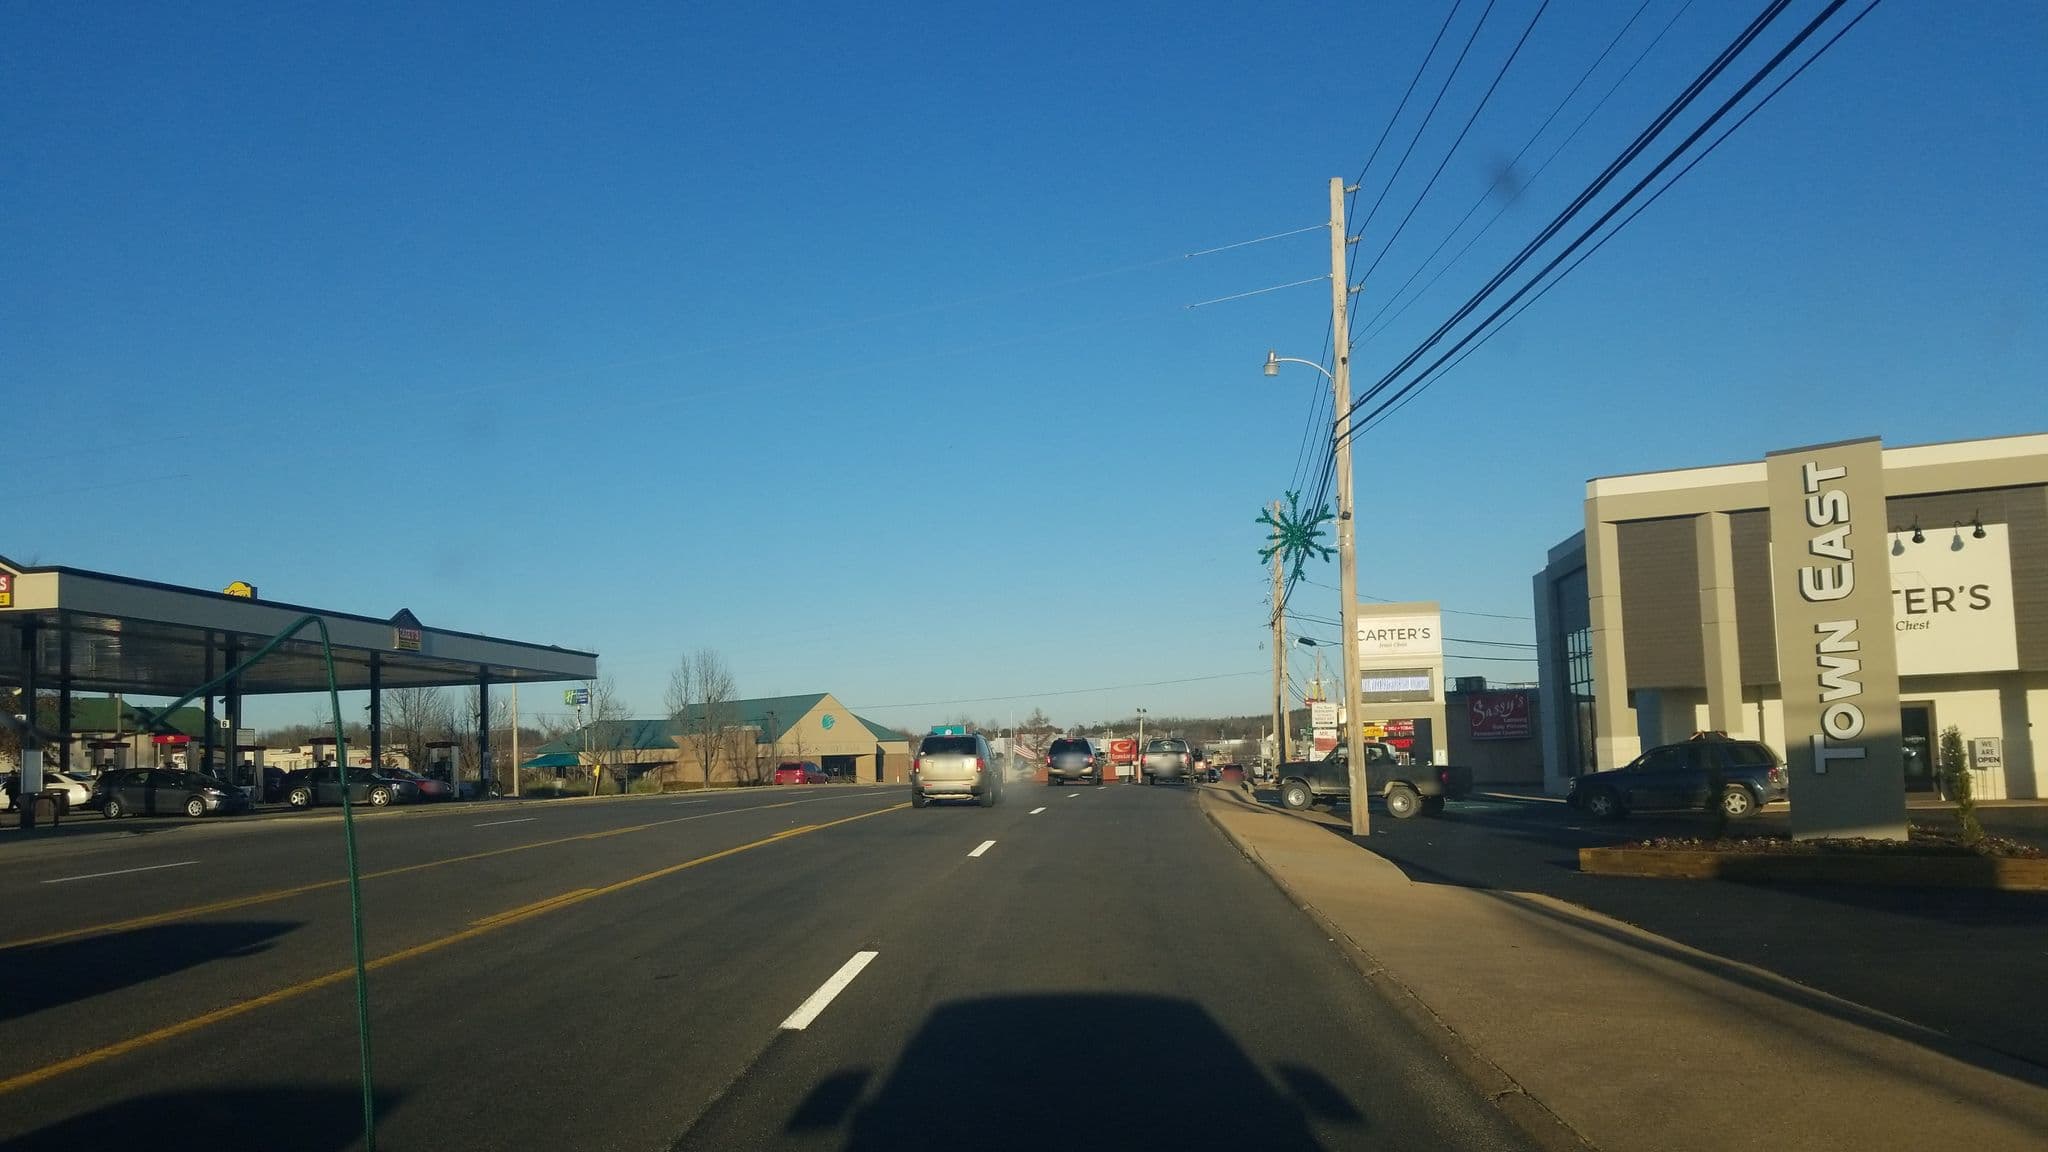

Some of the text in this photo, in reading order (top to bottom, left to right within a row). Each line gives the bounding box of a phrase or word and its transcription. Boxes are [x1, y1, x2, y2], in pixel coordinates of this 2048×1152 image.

[1892, 584, 1992, 615] ER'S
[1798, 461, 1867, 775] TOWN EAST
[1895, 620, 1930, 631] Chest
[1357, 627, 1431, 641] CARTER'S
